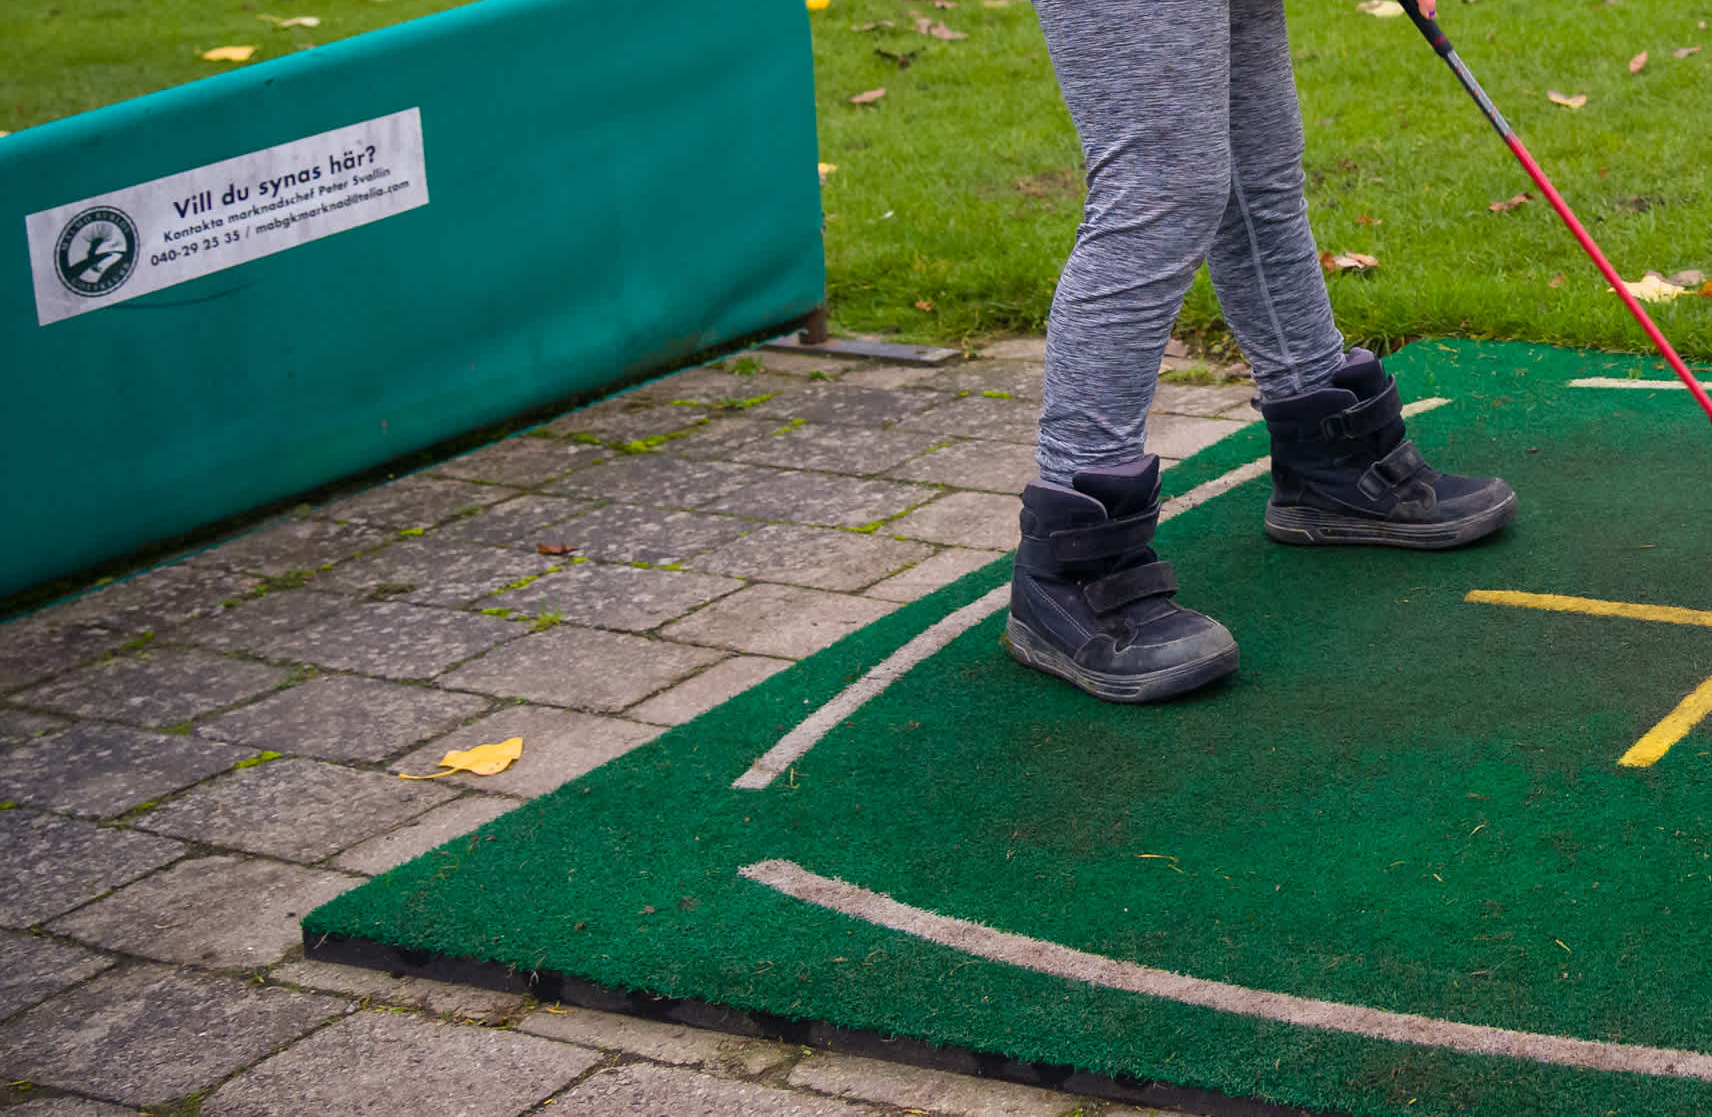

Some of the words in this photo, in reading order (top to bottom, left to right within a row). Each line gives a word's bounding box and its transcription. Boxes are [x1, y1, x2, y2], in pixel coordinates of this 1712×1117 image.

[163, 218, 224, 242] Kontakta
[228, 187, 314, 223] marknadschef
[318, 181, 348, 196] Peter
[353, 167, 391, 186] Svallin
[173, 190, 212, 218] Vill
[221, 183, 249, 206] du
[258, 166, 322, 198] synas
[328, 145, 376, 174] här?
[151, 242, 198, 266] 040-29
[203, 236, 220, 250] 25
[224, 230, 240, 244] 35
[255, 180, 410, 234] mabgkmarknad@telia.com
